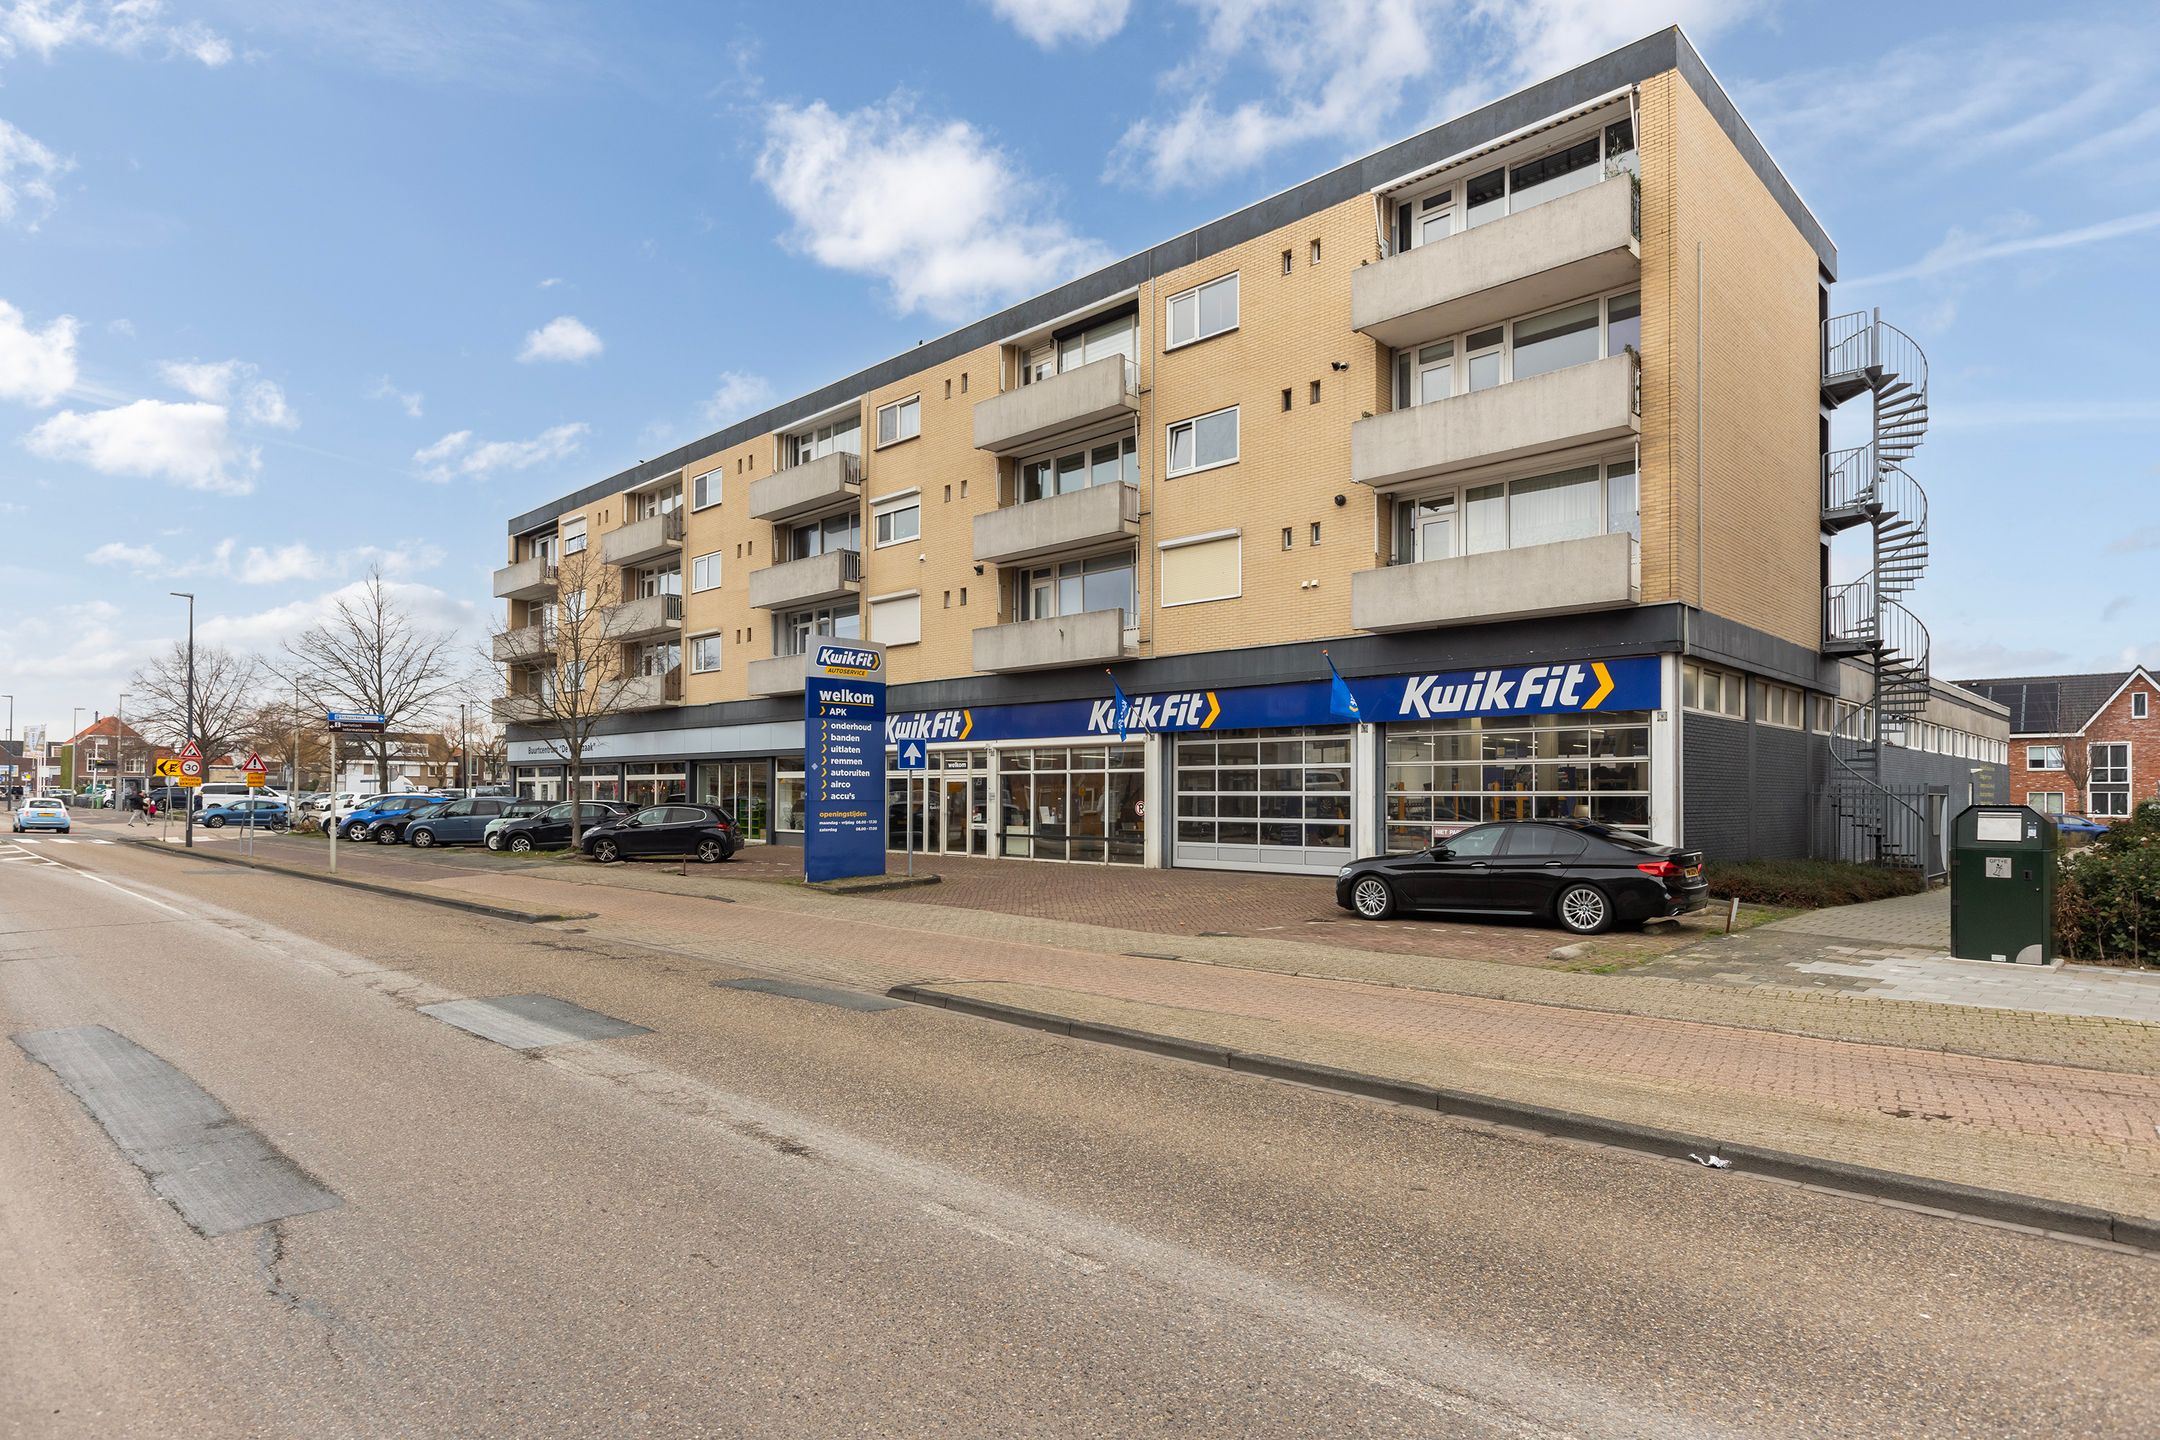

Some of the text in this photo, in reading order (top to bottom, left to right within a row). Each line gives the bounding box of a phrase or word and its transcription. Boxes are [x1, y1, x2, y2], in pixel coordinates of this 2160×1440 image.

[828, 667, 866, 676] AUTOSERVICE
[819, 689, 874, 704] welkom
[829, 707, 847, 716] APK
[830, 722, 872, 731] onderhoud
[830, 734, 860, 742] banden
[830, 745, 861, 753] uitlaten
[830, 769, 870, 777] autoruiten
[830, 780, 851, 788] airco
[830, 792, 856, 800] accu's
[819, 810, 867, 818] openingstijden
